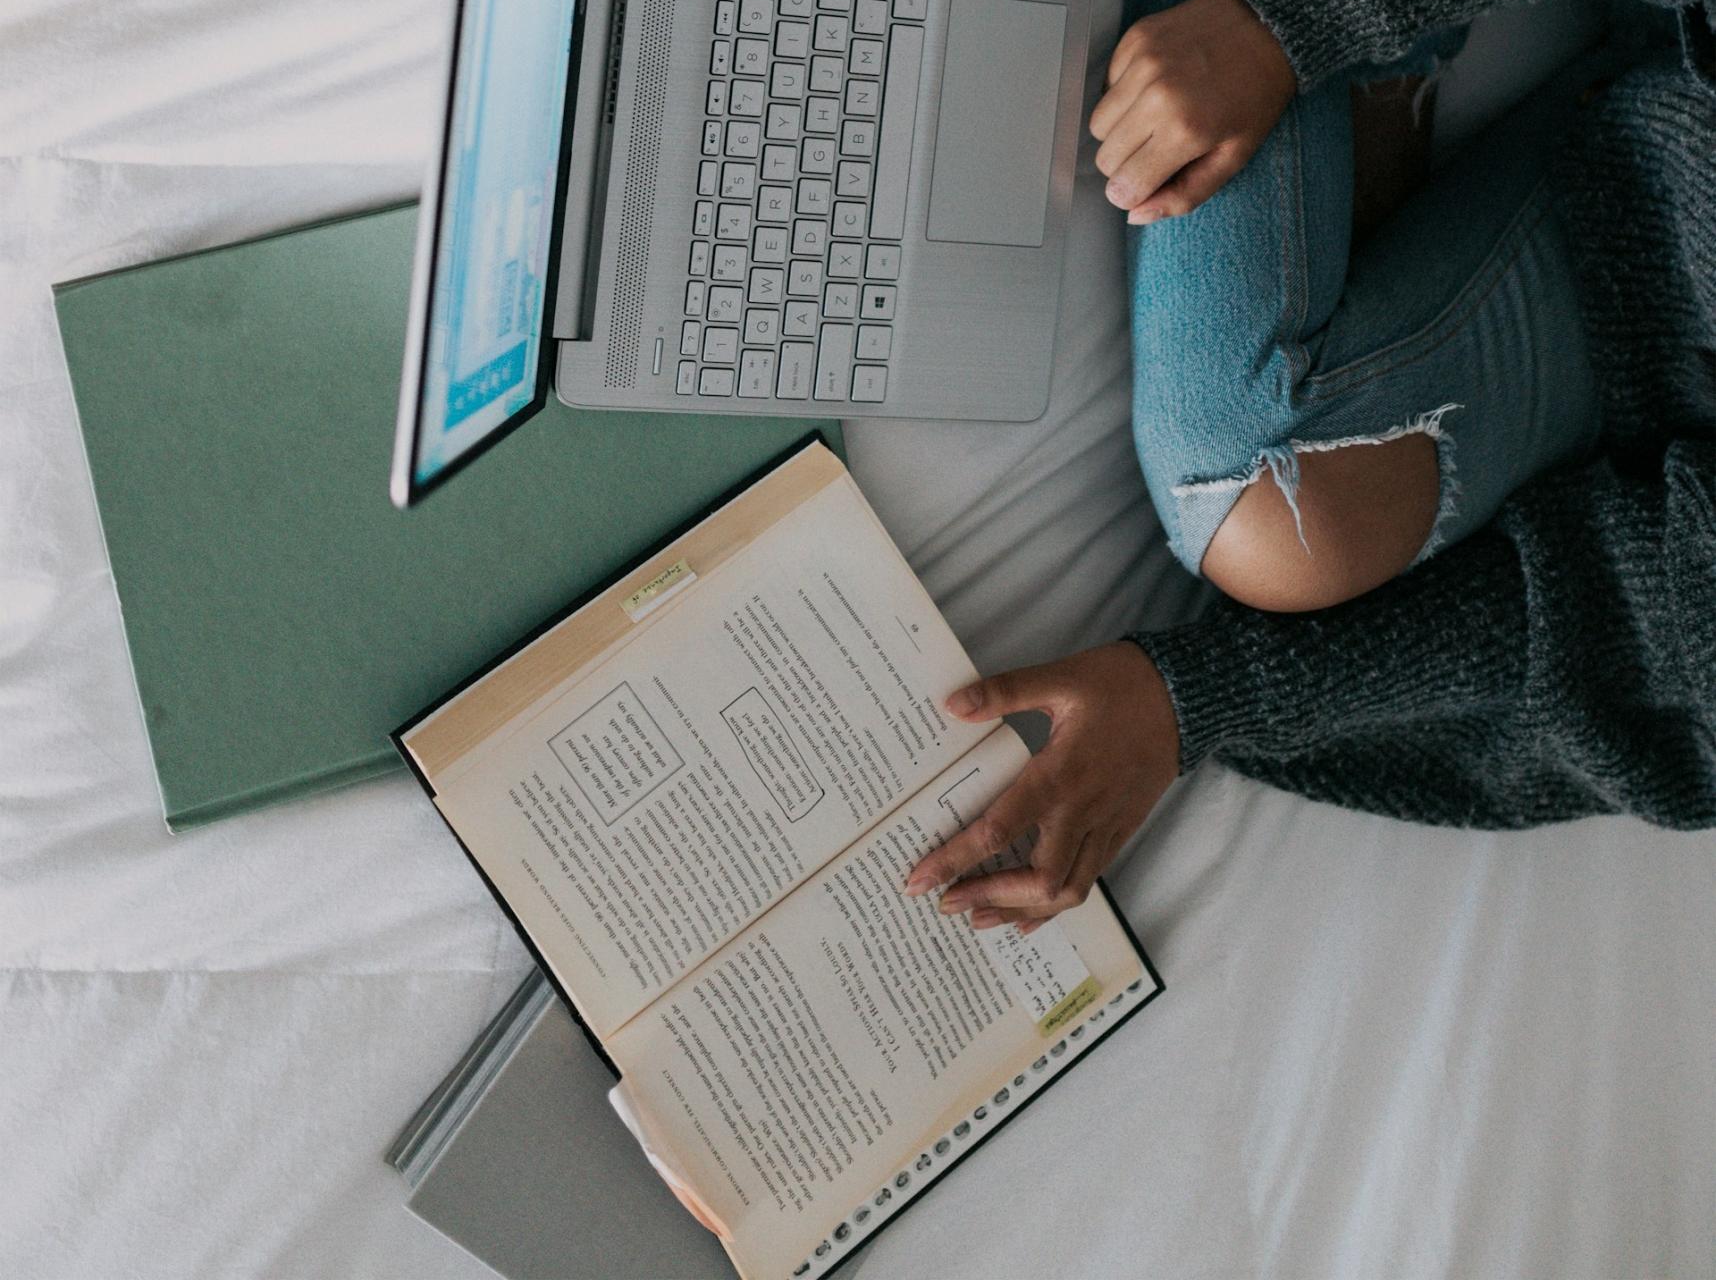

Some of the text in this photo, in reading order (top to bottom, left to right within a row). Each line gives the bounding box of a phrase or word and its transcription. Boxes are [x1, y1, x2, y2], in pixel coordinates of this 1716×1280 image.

[750, 11, 762, 20] 9
[825, 29, 837, 39] K
[746, 52, 757, 62] 8
[860, 51, 872, 63] M
[821, 69, 833, 78] J
[782, 75, 794, 86] U
[742, 93, 752, 101] 7
[856, 92, 868, 103] N
[816, 109, 828, 120] H
[777, 116, 789, 127] Y
[737, 135, 748, 144] 6
[852, 133, 864, 143] B
[812, 150, 825, 161] G
[773, 158, 785, 167] T
[733, 176, 744, 184] 5
[848, 173, 860, 184] V
[808, 191, 820, 201] F
[769, 199, 781, 209] R
[729, 218, 739, 226] 4
[844, 214, 856, 225] C
[804, 231, 816, 243] D
[765, 240, 777, 250] E
[724, 258, 736, 267] 3
[839, 255, 852, 265] X
[800, 273, 812, 282] S
[761, 277, 773, 293] W
[720, 300, 732, 308] 2
[835, 295, 848, 305] Z
[796, 312, 807, 324] A
[756, 320, 768, 333] Q
[623, 712, 648, 743] actually
[607, 717, 655, 779] nothing to do with
[643, 739, 654, 751] we
[649, 749, 666, 769] what
[740, 711, 807, 803] Emotion: something we feel
[758, 712, 818, 795] Action: something we do
[580, 732, 633, 799] of the impression we
[600, 734, 644, 789] often convey has
[727, 714, 798, 811] Thought: something we know
[564, 736, 617, 809] More than 90 percent
[506, 786, 631, 960] more than 90 percent of the impression we often
[842, 862, 885, 923] UCLA psychology
[518, 856, 607, 979] CONNECTING GOES BEYOND WORDS
[834, 939, 856, 971] WORDS
[849, 969, 868, 994] YOUR
[816, 935, 899, 1075] YOUR ACTIONS SPEAK SO LOUDLY,
[860, 991, 880, 1017] HEAR
[874, 1015, 896, 1046] CAN'T
